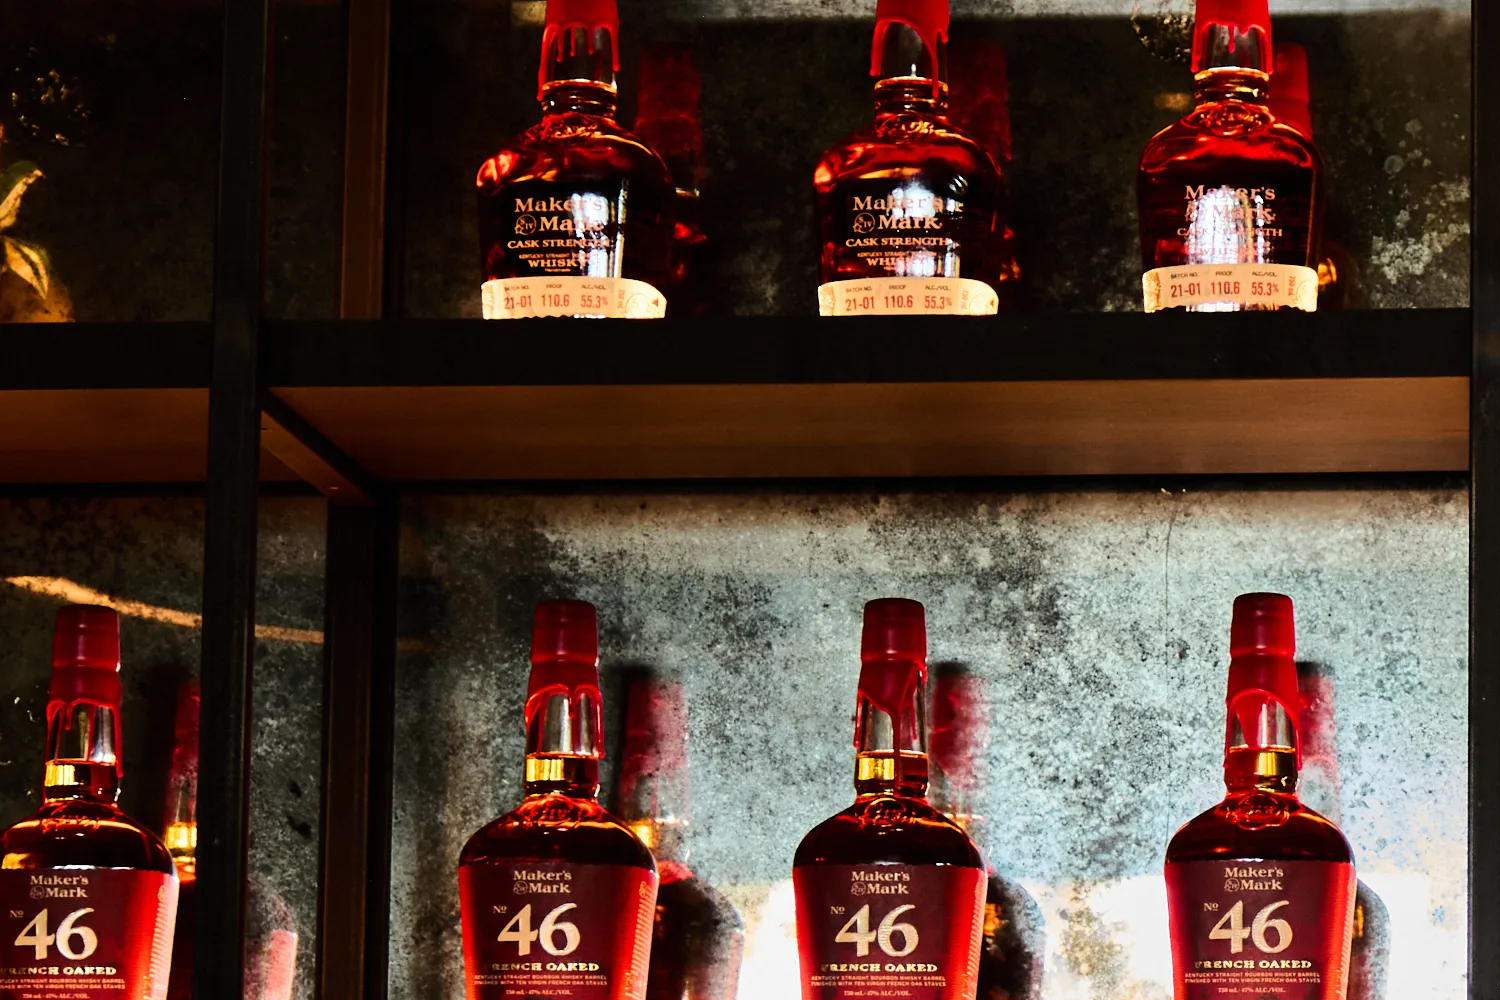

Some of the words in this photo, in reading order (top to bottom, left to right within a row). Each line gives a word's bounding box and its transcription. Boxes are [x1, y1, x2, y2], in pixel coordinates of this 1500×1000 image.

[1184, 185, 1275, 200] Maker's
[853, 196, 943, 212] Maker's
[1213, 205, 1276, 220] Mark
[878, 215, 942, 229] Mark
[1177, 228, 1212, 237] CASK
[507, 239, 540, 248] CASK
[846, 238, 878, 247] CASK
[881, 237, 948, 246] STRENGTH
[528, 259, 589, 268] WHISKY
[1171, 285, 1200, 297] 21-01
[1211, 282, 1240, 294] 110.6
[1252, 282, 1278, 296] 55.3%
[504, 295, 532, 309] 21-01
[541, 295, 570, 307] 110.6
[581, 295, 608, 308] 55.3%
[846, 297, 875, 311] 21-01
[885, 295, 913, 308] 110.6
[924, 296, 952, 309] 55.3%
[514, 871, 572, 880] Maker's
[851, 871, 910, 882] Maker's
[1224, 867, 1284, 878] Maker's
[30, 876, 89, 885] Maker's
[1240, 879, 1283, 890] Mark
[45, 887, 87, 898] Mark
[529, 883, 570, 893] Mark
[866, 883, 908, 894] Mark
[497, 903, 581, 956] 46
[835, 904, 919, 957] 46
[1209, 900, 1293, 954] 46
[14, 907, 98, 961] 46
[546, 963, 600, 971] OAKED
[821, 964, 880, 972] FRENCH
[885, 963, 938, 972] OAKED
[1195, 960, 1254, 968] FRENCH
[1259, 960, 1312, 968] OAKED
[0, 967, 59, 975] RENCH
[63, 967, 116, 975] OAKED
